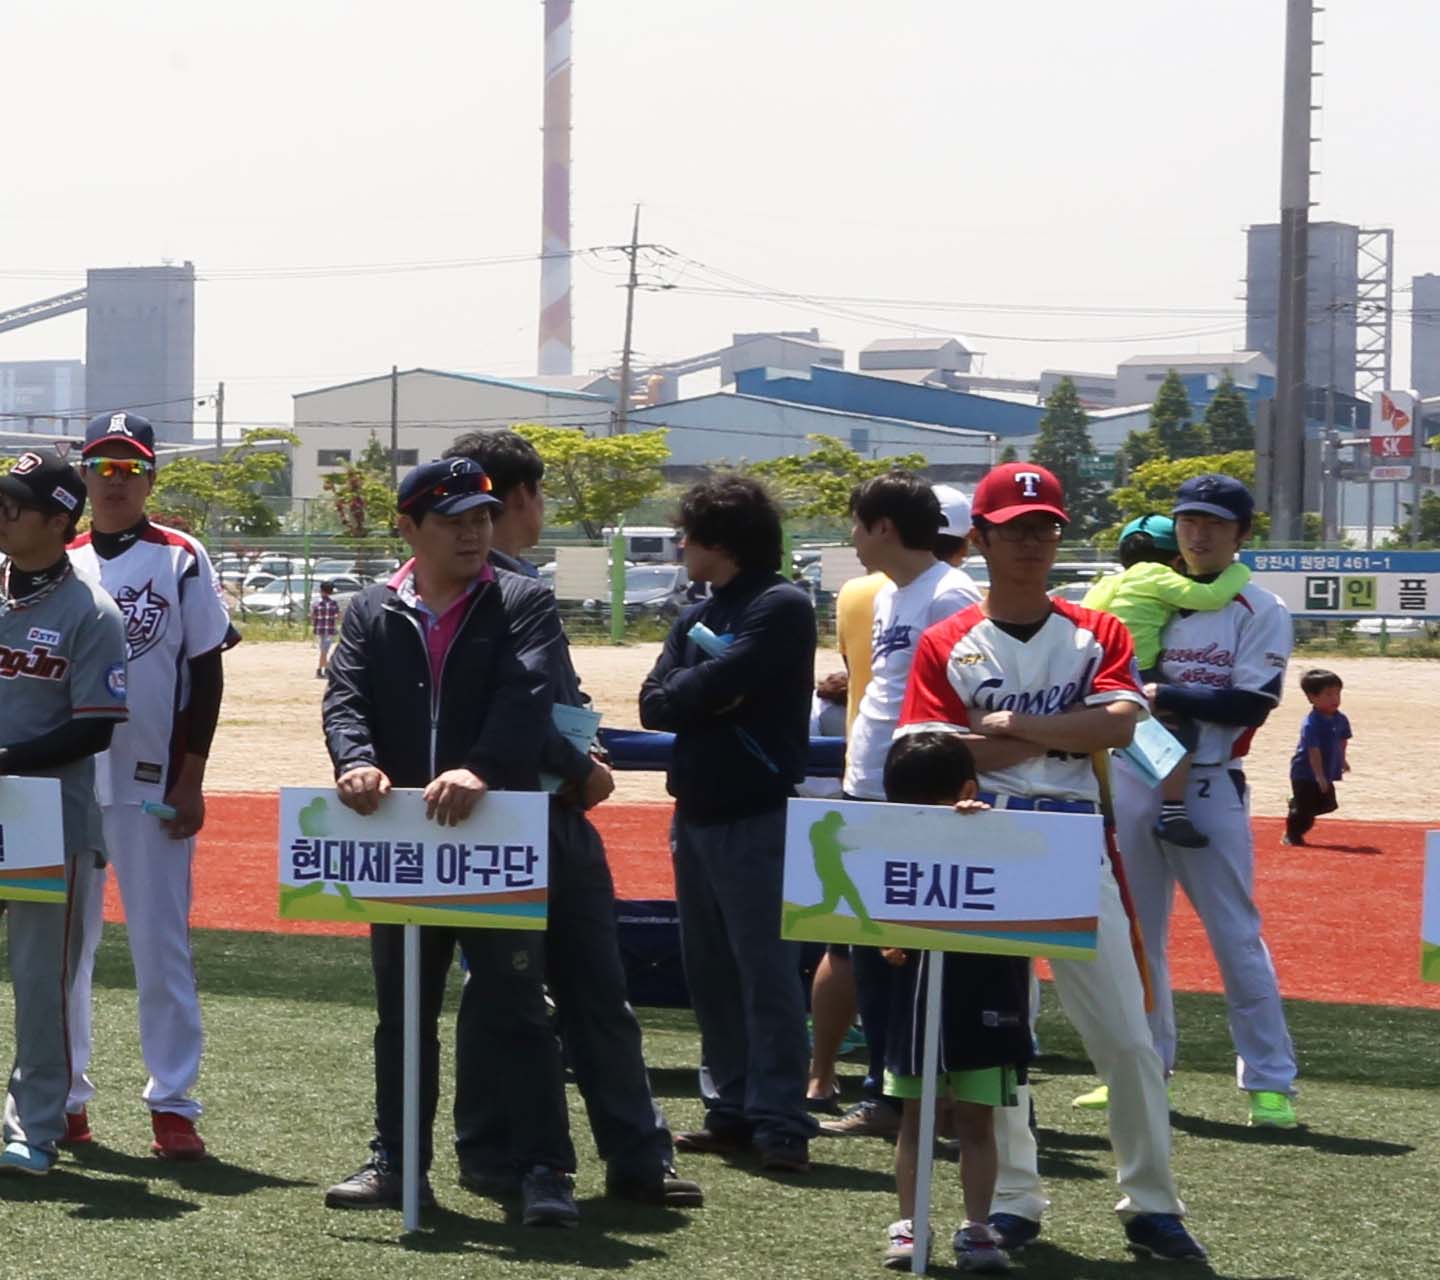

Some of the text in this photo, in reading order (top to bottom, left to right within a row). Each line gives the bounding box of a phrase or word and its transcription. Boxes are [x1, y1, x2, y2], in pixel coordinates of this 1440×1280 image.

[1382, 437, 1400, 456] SK
[1015, 472, 1040, 497] T
[1254, 555, 1296, 569] 당진시
[1343, 556, 1393, 569] 461-1
[1197, 779, 1211, 798] 2
[290, 838, 540, 888] 현대제철 야구단
[883, 860, 995, 911] 탑시드
